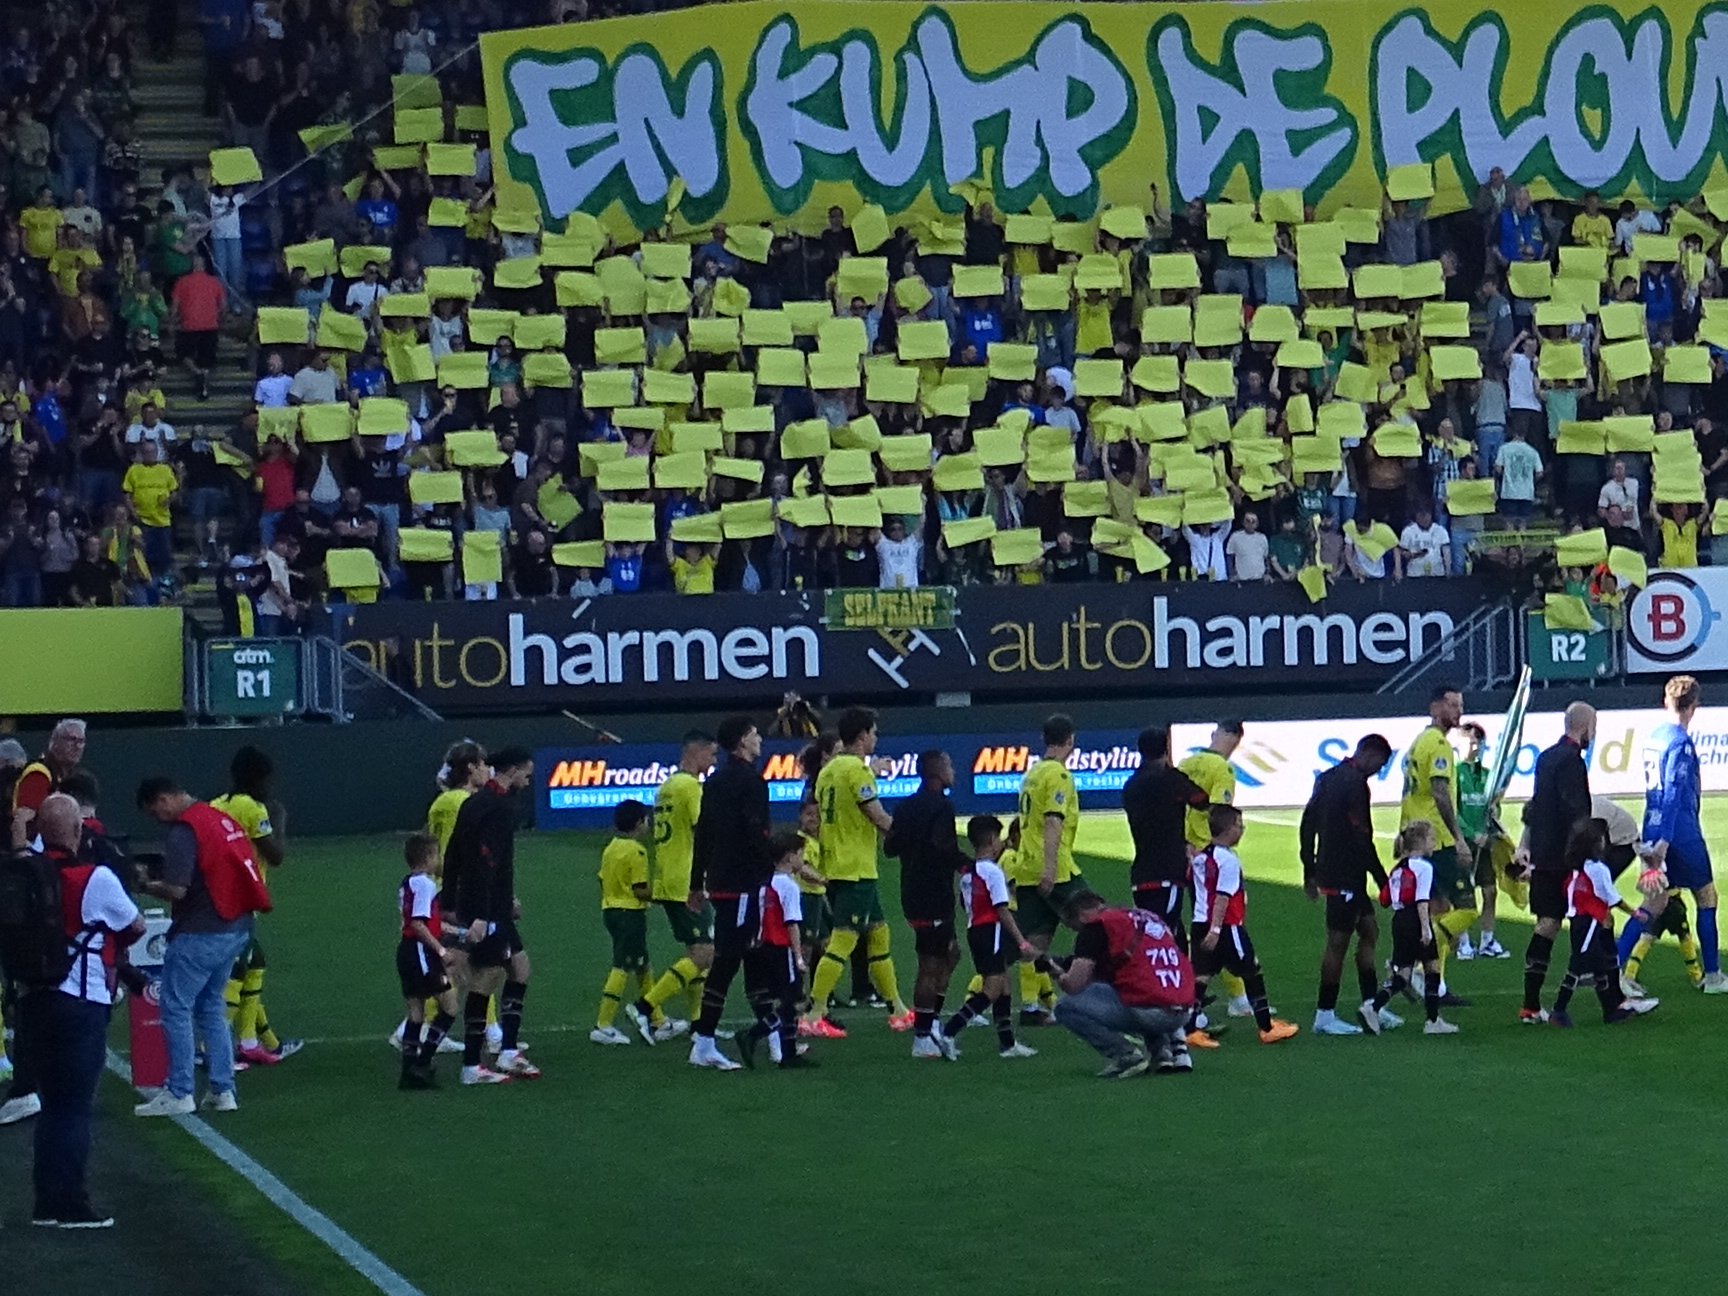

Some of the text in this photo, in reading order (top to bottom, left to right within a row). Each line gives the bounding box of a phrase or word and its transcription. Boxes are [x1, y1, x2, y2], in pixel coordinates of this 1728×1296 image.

[506, 47, 720, 222] EN
[744, 10, 1132, 204] KUMP
[1152, 14, 1352, 200] DE
[988, 594, 1456, 674] autoharmen
[1551, 634, 1587, 662] R2
[236, 669, 271, 698] R1
[1155, 969, 1180, 989] TV
